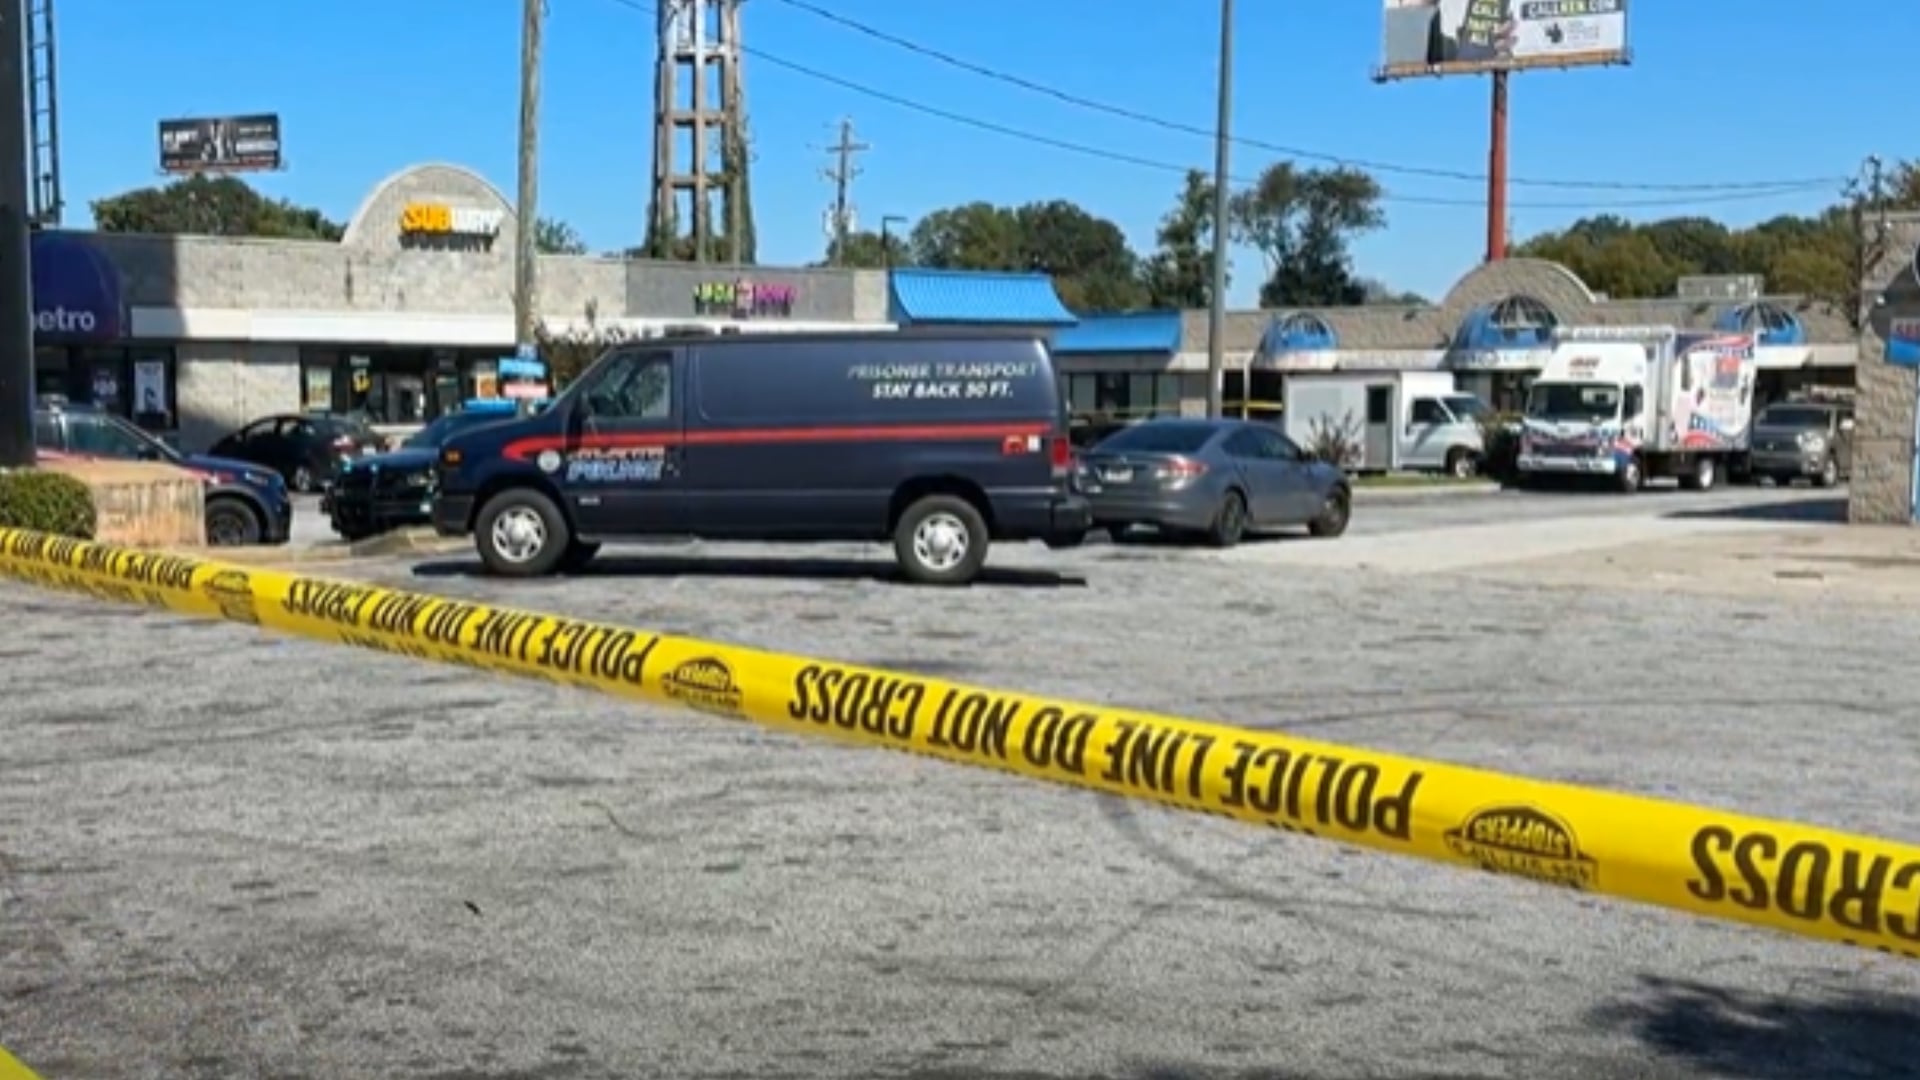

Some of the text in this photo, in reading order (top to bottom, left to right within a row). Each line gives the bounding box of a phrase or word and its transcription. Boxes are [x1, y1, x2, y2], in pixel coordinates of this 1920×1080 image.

[402, 202, 502, 233] SUBWAY
[34, 307, 95, 331] etro
[848, 361, 1037, 379] PRISONER TRANSPORT
[873, 381, 1014, 399] STAY BACK 50 FT.
[566, 460, 663, 481] POLICE
[282, 578, 375, 626] CROSS
[369, 587, 428, 635] NOT
[424, 596, 470, 644] DO
[470, 606, 543, 660] LINE
[537, 616, 660, 684] POLICE
[788, 664, 924, 740] CROSS
[926, 688, 1020, 759] NOT
[1023, 707, 1096, 774] DO
[1101, 719, 1217, 797] LINE
[1222, 740, 1423, 841] POLICE
[1687, 825, 1920, 943] CROSS
